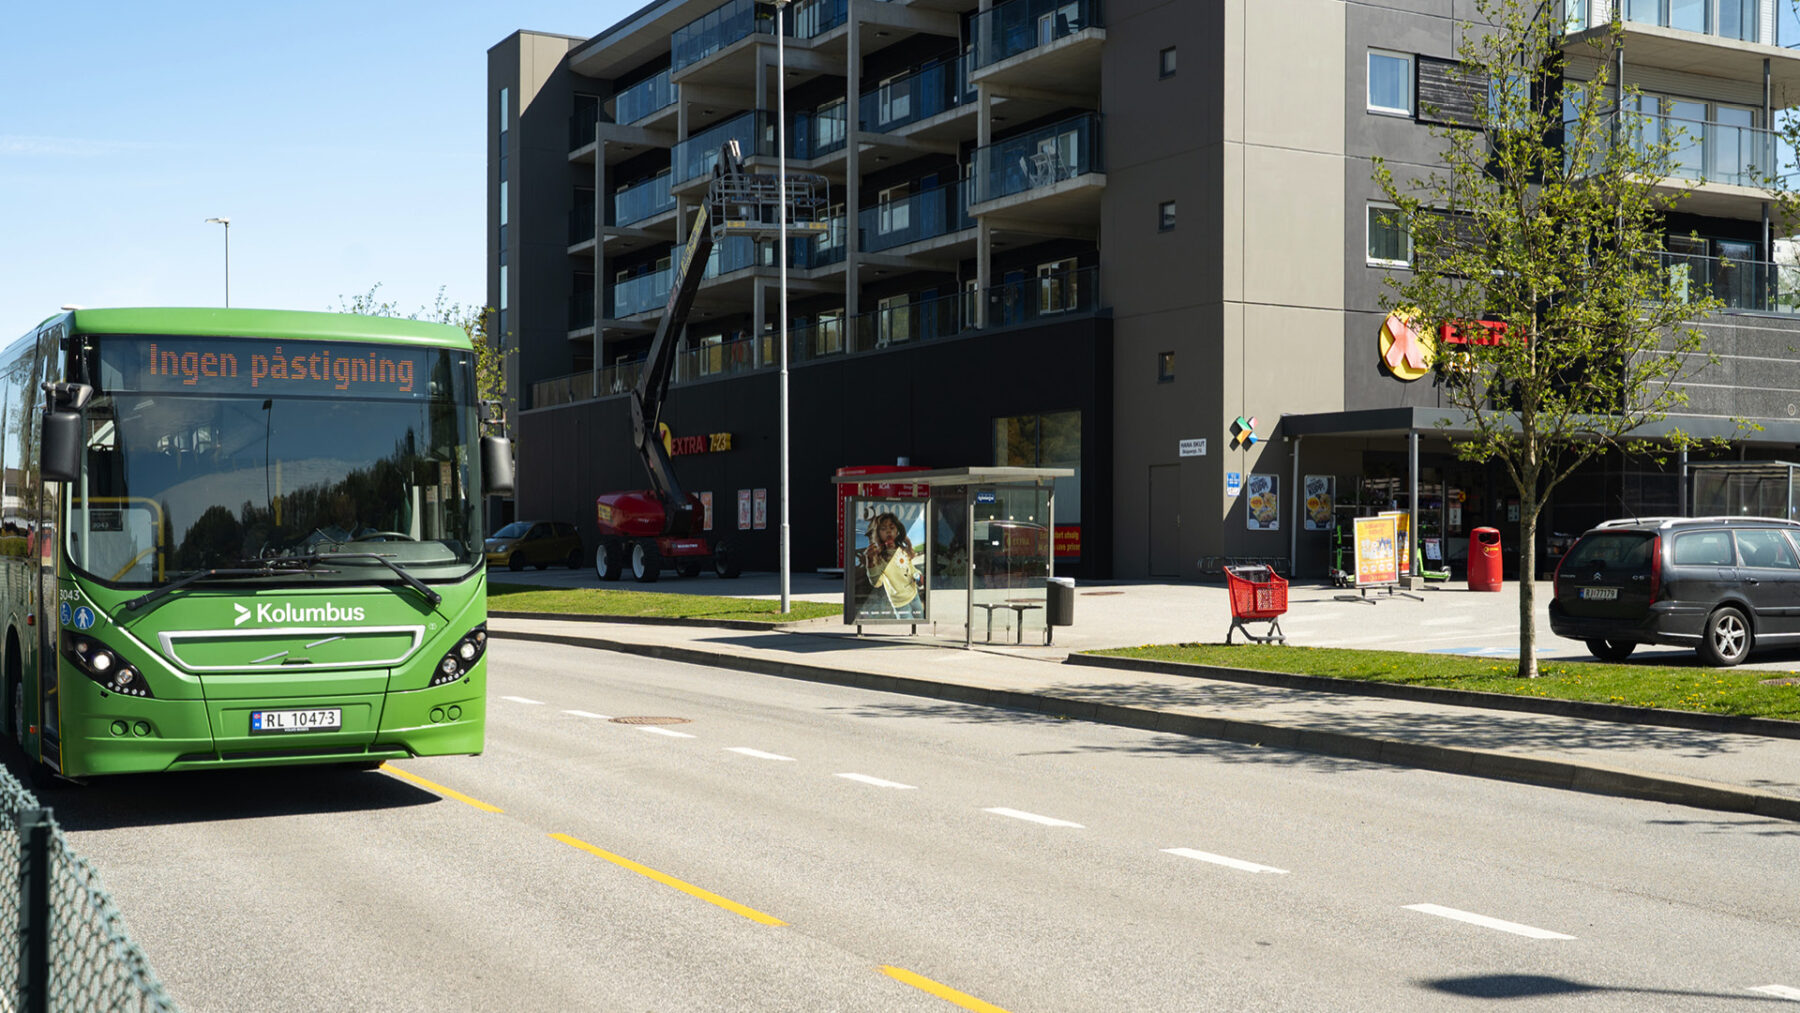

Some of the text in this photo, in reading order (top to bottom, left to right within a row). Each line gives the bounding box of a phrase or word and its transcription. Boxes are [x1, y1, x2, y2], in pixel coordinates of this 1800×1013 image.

[150, 343, 414, 392] Ingen påstigning
[671, 433, 730, 455] EXTRA 7-23
[257, 602, 365, 623] Kolumbus
[266, 711, 336, 728] RL 10473
